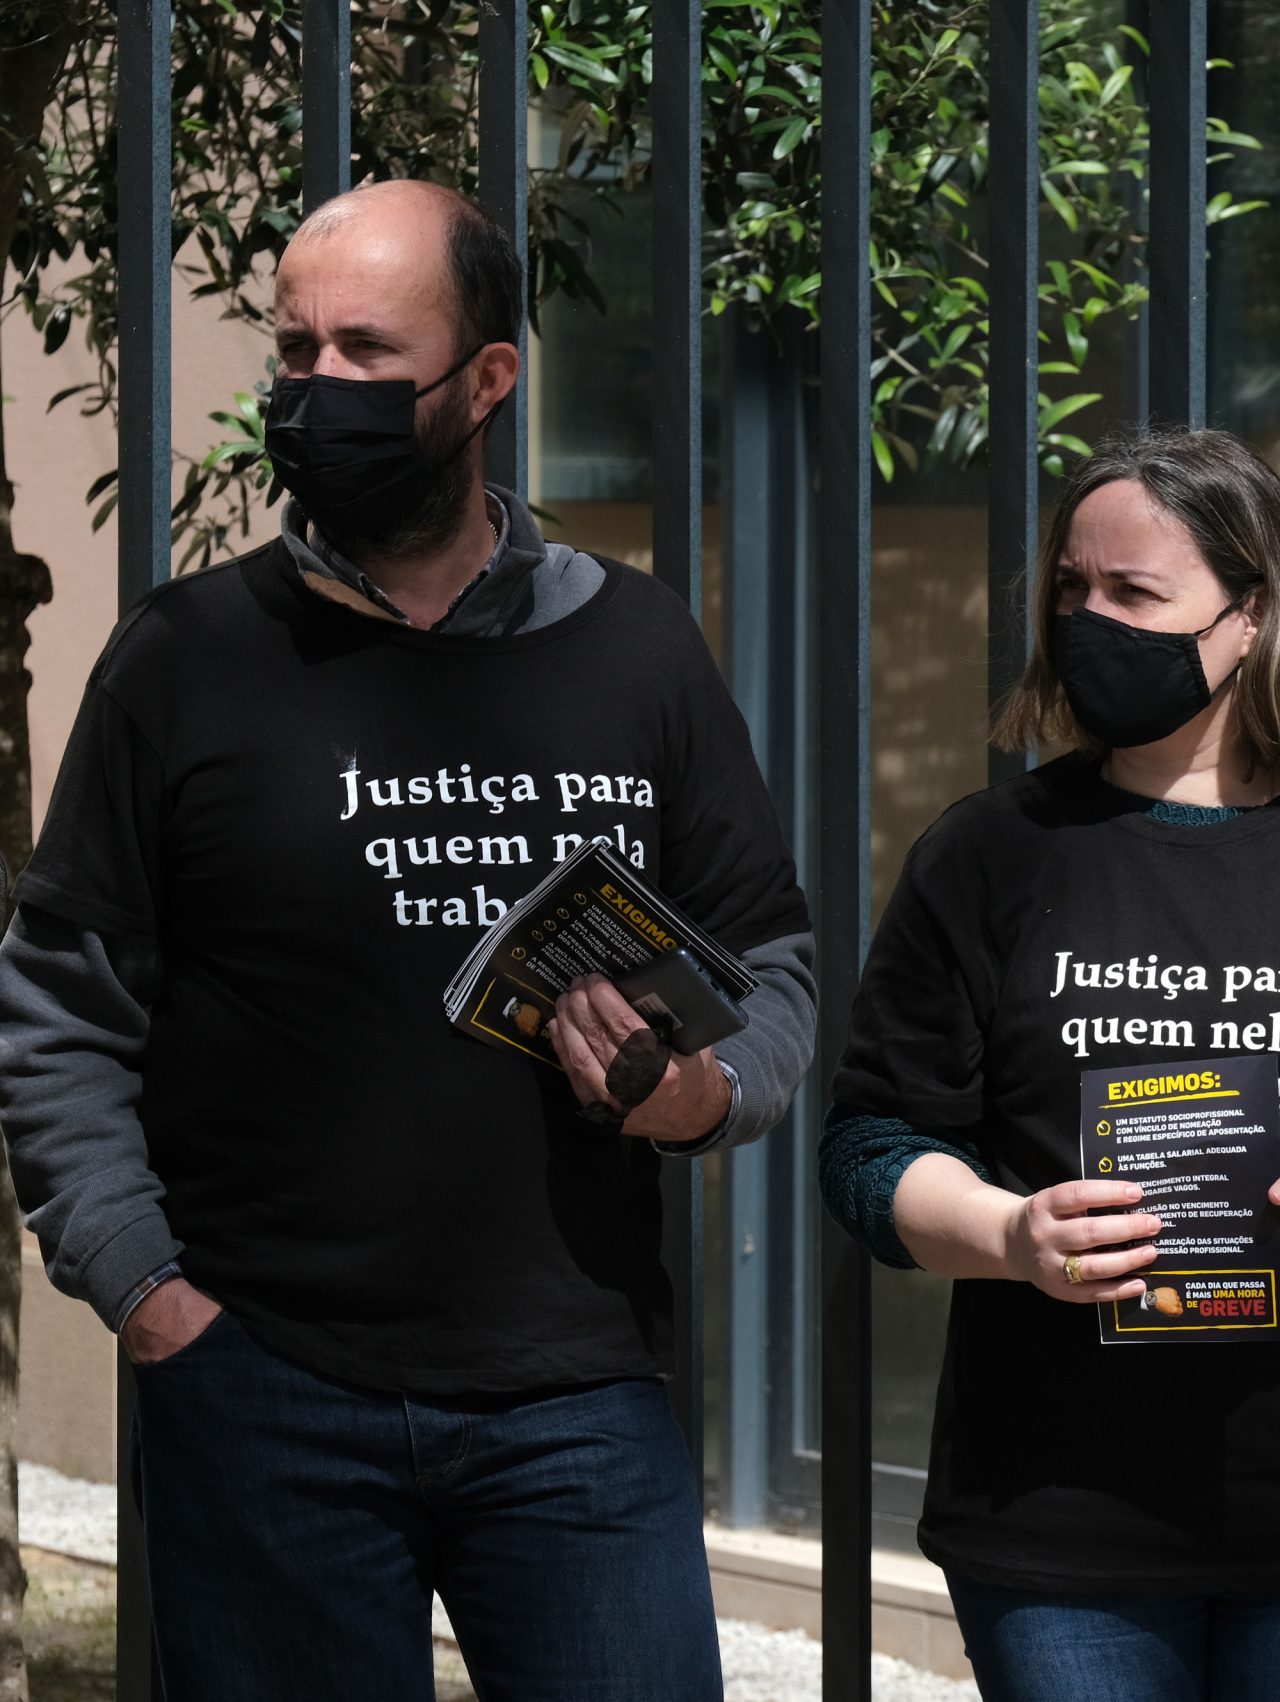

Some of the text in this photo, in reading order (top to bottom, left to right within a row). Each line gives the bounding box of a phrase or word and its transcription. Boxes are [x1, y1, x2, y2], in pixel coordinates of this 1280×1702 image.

[340, 764, 654, 820] Justiça para
[364, 832, 533, 879] quem
[393, 884, 522, 927] trab
[600, 883, 677, 949] EXIGIMO
[587, 908, 602, 922] COM
[601, 921, 628, 945] VÍNCULO
[627, 944, 637, 953] DE
[591, 904, 653, 960] UM ESTATUTO SOCIO
[574, 919, 631, 970] UMA TABELA SALA
[588, 917, 611, 938] REGIME
[610, 937, 642, 965] ESPECÍFIC
[567, 935, 613, 978] PREENCHIMENT
[1050, 951, 1208, 1000] Justiça
[1061, 1016, 1195, 1057] quem
[1108, 1071, 1221, 1101] EXIGIMOS:
[1116, 1109, 1245, 1126] UM ESTATUTO SOCIOPROFISSIONAL
[1116, 1119, 1222, 1135] COM VÍNCULO DE NOMEAÇÃO
[1123, 1134, 1151, 1143] REGIME
[1152, 1130, 1196, 1141] ESPECÍFICO
[1196, 1129, 1207, 1137] DE
[1208, 1125, 1266, 1136] APOSENTAÇÃO.
[1117, 1146, 1247, 1163] UMA TABELA SALARIAL ADEQUADA
[1118, 1160, 1167, 1172] ÀS FUNÇÕES.
[1137, 1174, 1229, 1189] ENCHIMENTO INTEGRAL
[1141, 1184, 1200, 1197] UGARES VAGOS.
[1154, 1211, 1187, 1219] EMENTO
[1199, 1208, 1253, 1218] RECUPERAÇÃO
[1181, 1201, 1230, 1210] VENCIMENTO
[1197, 1237, 1212, 1245] DAS
[1213, 1236, 1254, 1245] SITUAÇÕES
[1155, 1246, 1244, 1255] GRESSÃO PROFISSIONAL.
[1239, 1281, 1265, 1289] PASSA
[1185, 1290, 1192, 1299] É
[1213, 1290, 1235, 1299] UMA
[1237, 1289, 1265, 1298] HORA
[1200, 1300, 1266, 1316] GREVE
